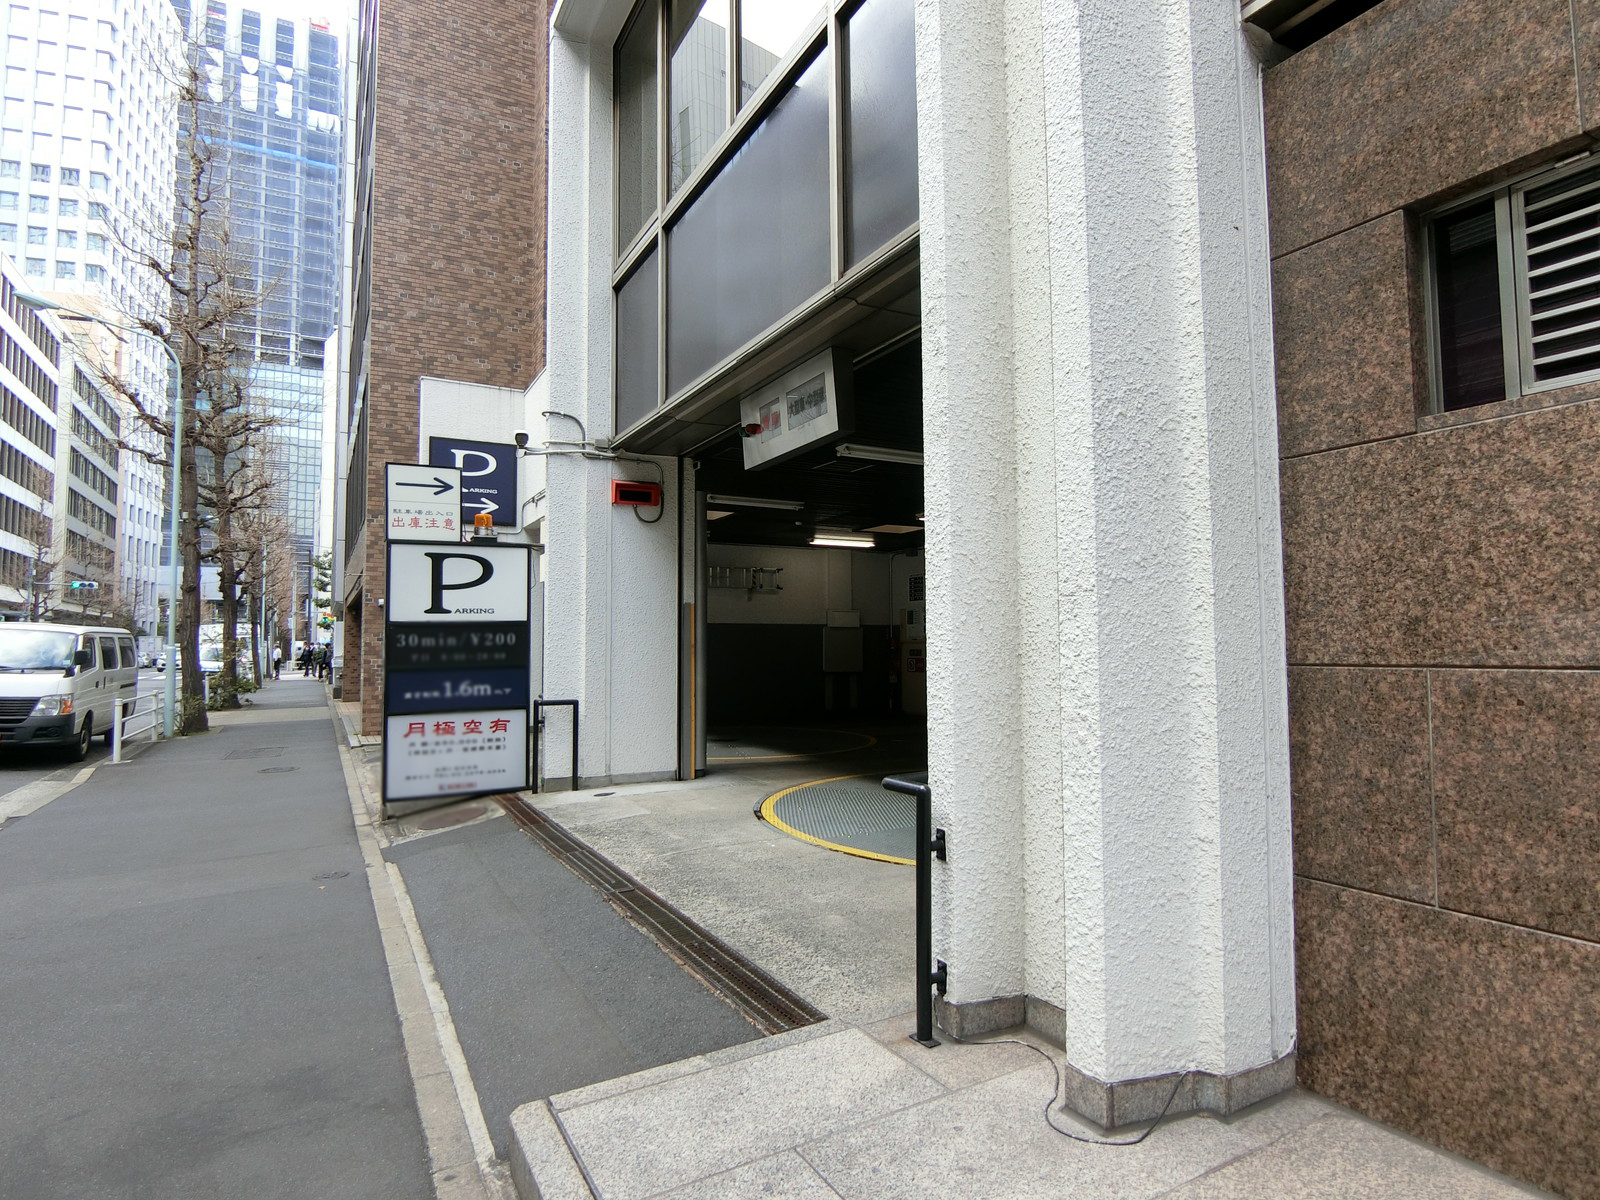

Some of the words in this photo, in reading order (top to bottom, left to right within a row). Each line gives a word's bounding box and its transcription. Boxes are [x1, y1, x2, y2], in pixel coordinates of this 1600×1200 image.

[392, 516, 456, 531] 出庫注意
[403, 718, 511, 738] 月極空有
